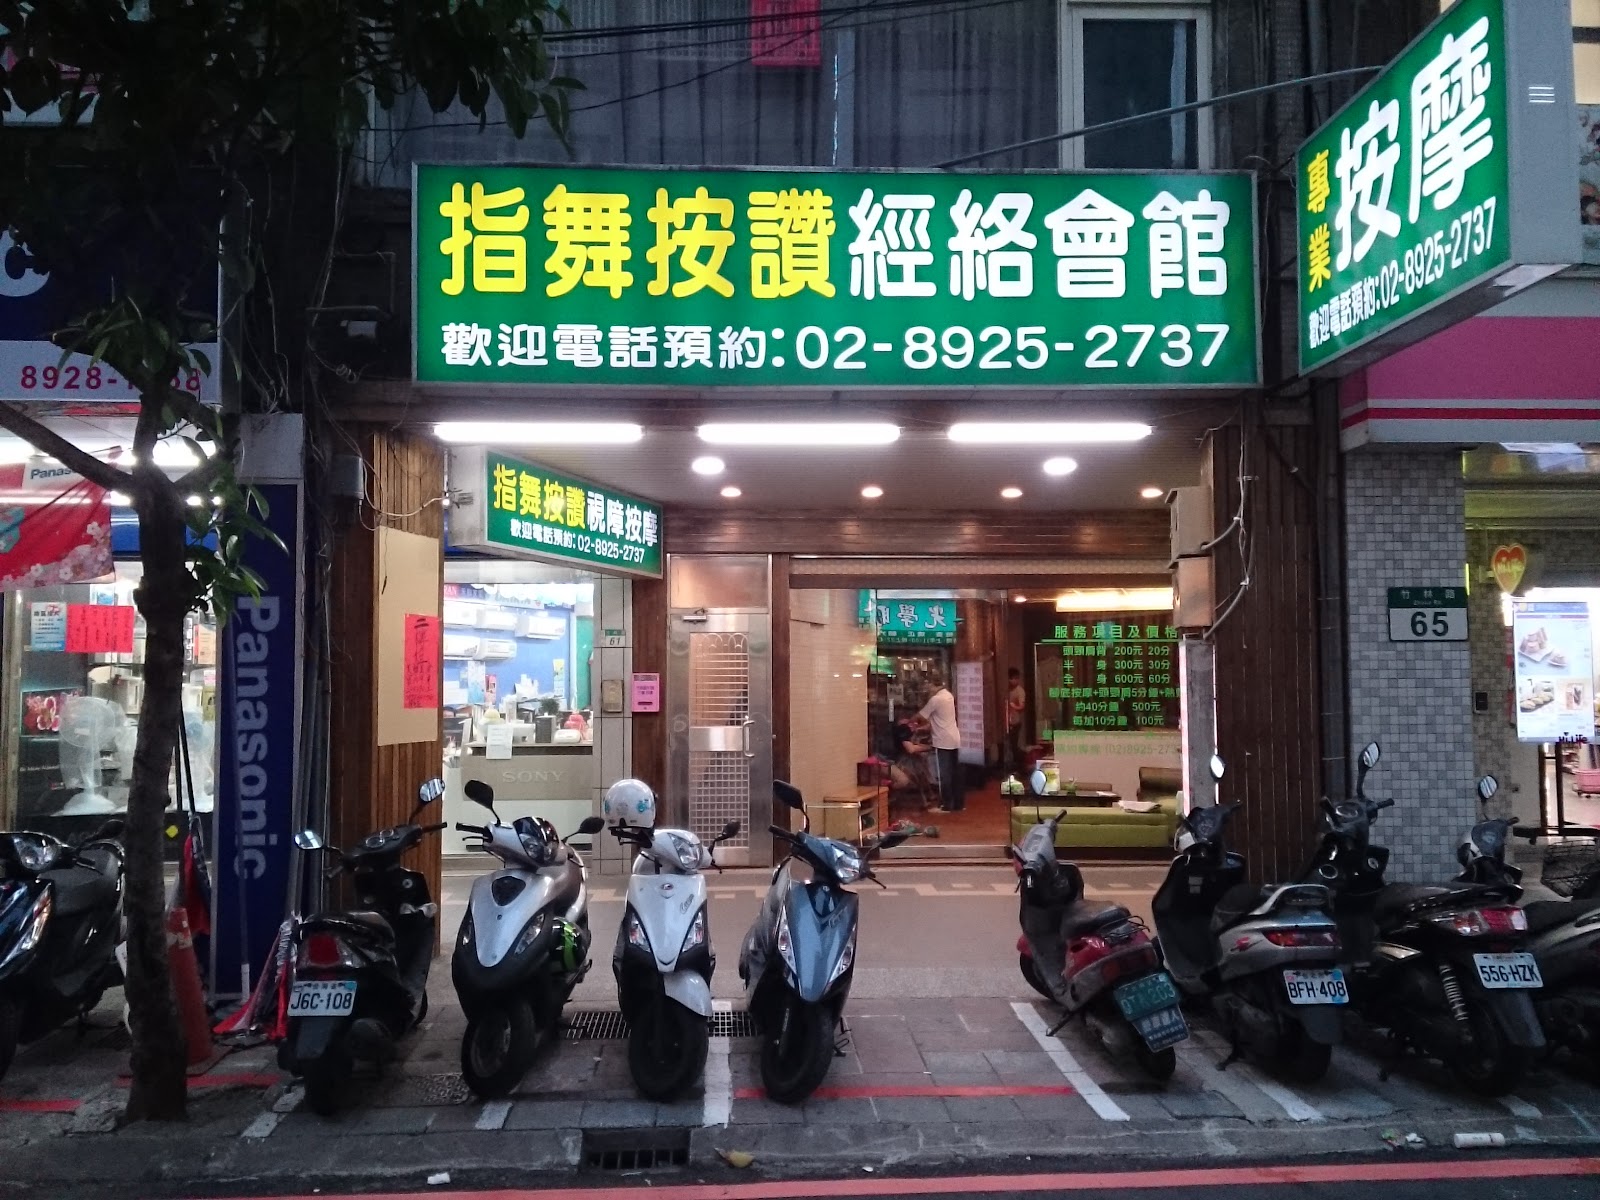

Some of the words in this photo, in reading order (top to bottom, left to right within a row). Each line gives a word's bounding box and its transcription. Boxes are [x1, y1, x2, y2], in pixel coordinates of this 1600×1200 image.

[1334, 15, 1494, 272] 按摩
[1307, 148, 1332, 294] 專業
[439, 181, 1230, 301] 指舞按讚經絡會館
[20, 365, 202, 391] 8928-8
[30, 467, 76, 480] Panas
[493, 462, 658, 548] 指舞按讚視障按摩
[1400, 589, 1456, 600] 竹林路
[1410, 611, 1449, 637] 65
[1054, 625, 1179, 639] 服務項目及價格
[609, 637, 621, 646] 61
[1114, 646, 1144, 656] 200元
[1148, 646, 1170, 656] 20分
[1114, 660, 1144, 670] 300元
[1148, 660, 1171, 670] 30分
[1114, 674, 1144, 684] 600元
[1148, 674, 1171, 684] 60分
[1132, 702, 1161, 712] 500元
[1136, 716, 1165, 726] 100元
[233, 595, 281, 880] Panasonic
[502, 770, 567, 783] SONY
